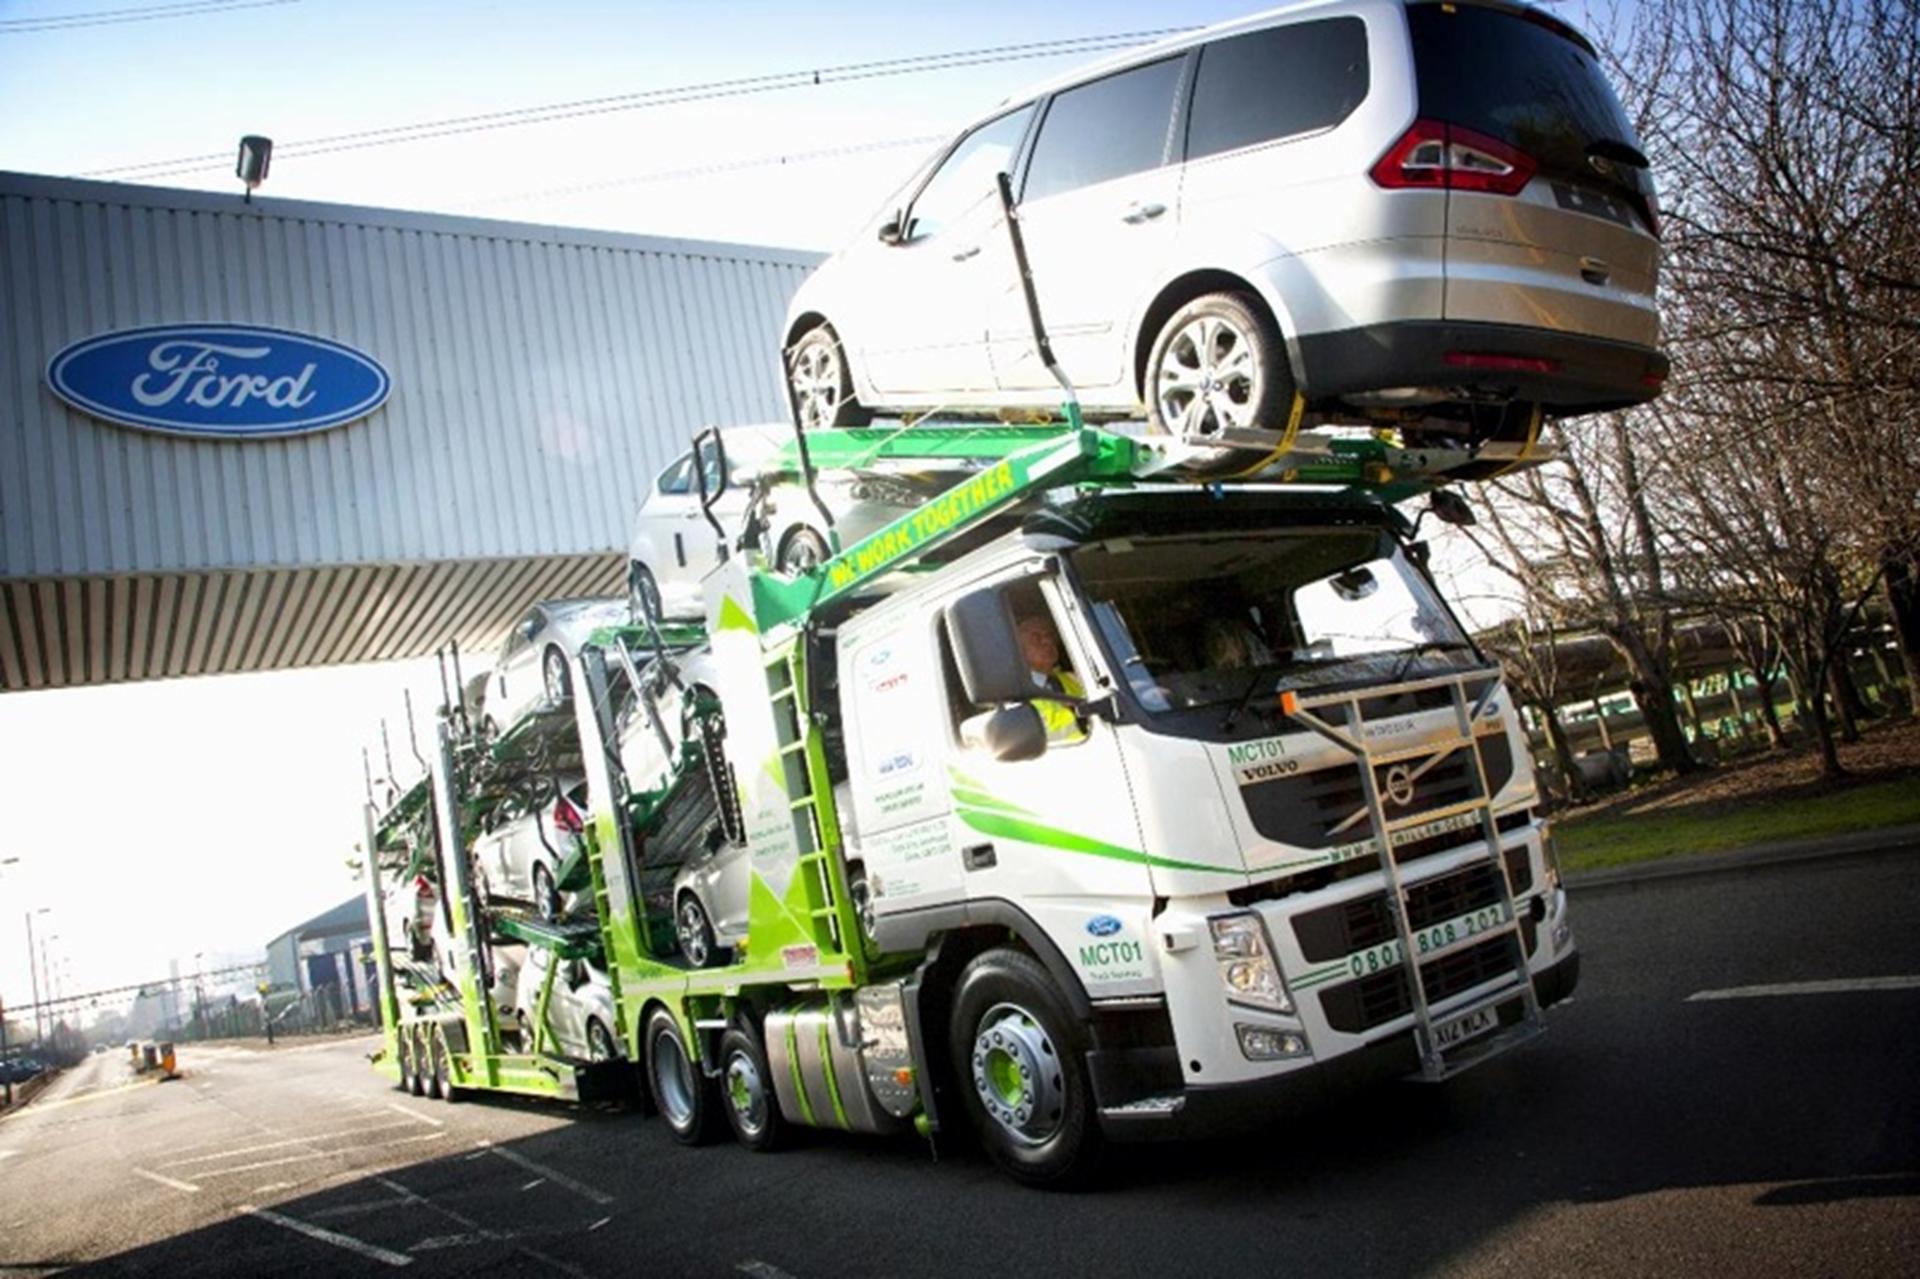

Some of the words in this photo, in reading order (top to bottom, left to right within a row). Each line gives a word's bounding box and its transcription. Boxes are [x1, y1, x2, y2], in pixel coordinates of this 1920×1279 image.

[131, 340, 316, 408] Ford
[857, 528, 912, 573] WORK
[912, 459, 1013, 540] TOGETHER
[1227, 739, 1285, 765] MCT01
[1242, 760, 1298, 780] VOLVO
[1417, 923, 1456, 953] 808
[1079, 941, 1142, 966] MCT01
